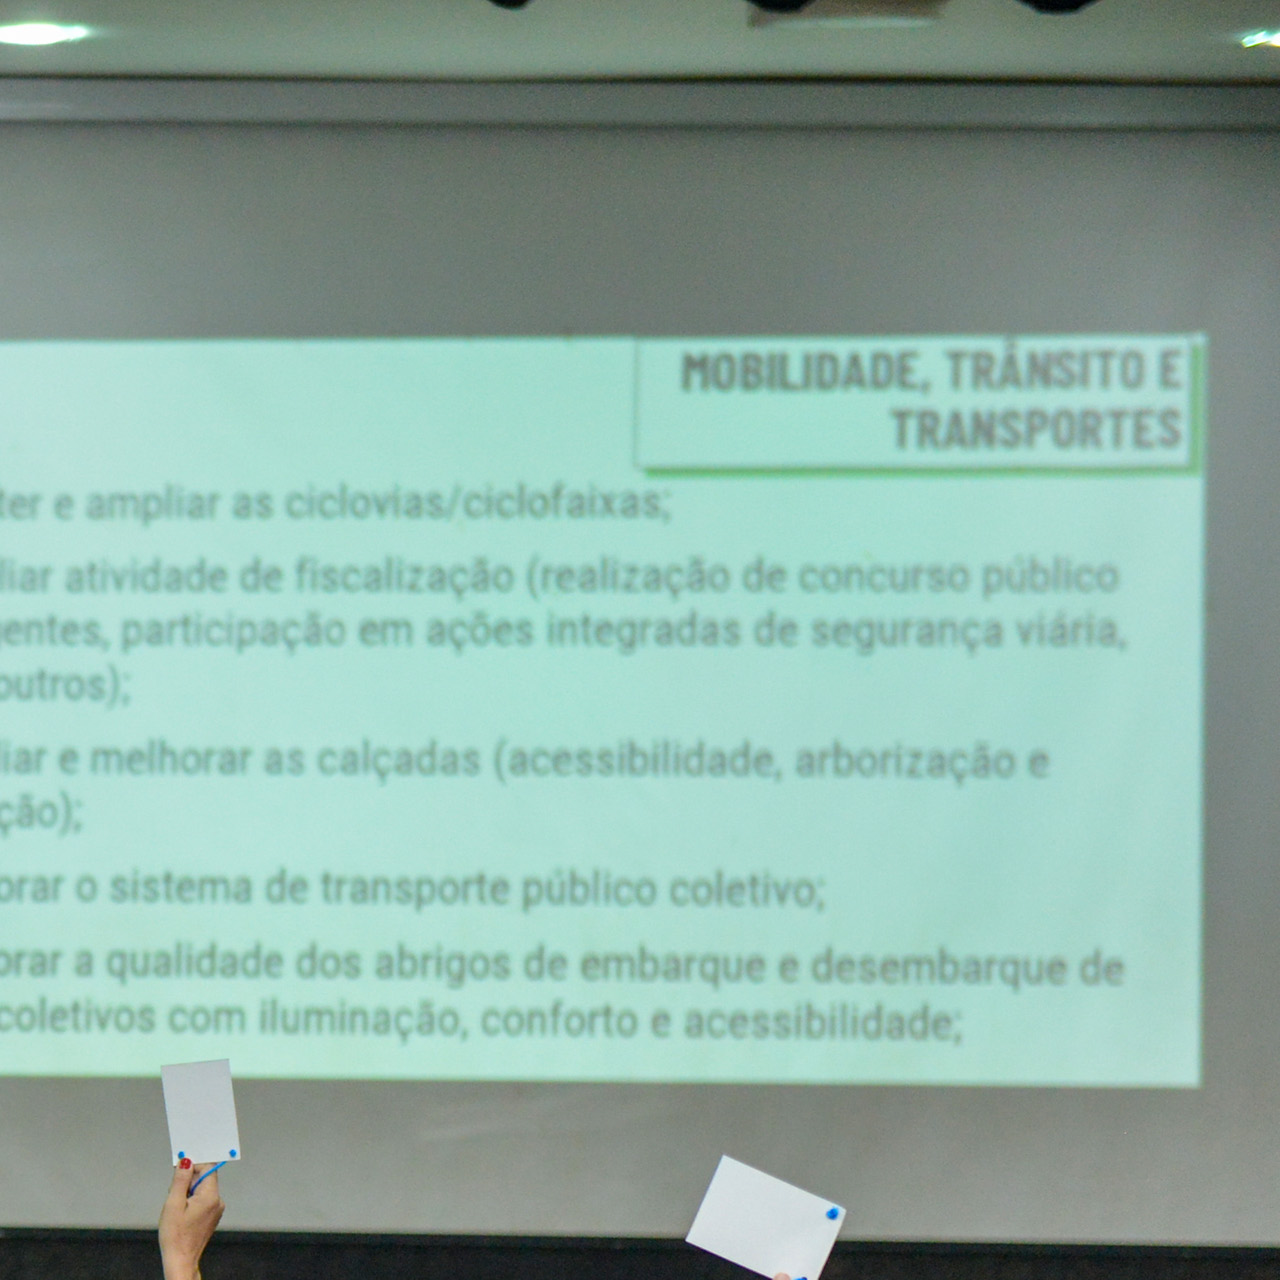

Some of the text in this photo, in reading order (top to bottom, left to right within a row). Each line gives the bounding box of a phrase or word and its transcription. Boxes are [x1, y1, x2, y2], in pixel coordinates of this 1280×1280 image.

[680, 338, 1181, 396] MOBILIDADE, TRÂNSITO E
[892, 408, 1180, 450] TRANSPORTES
[53, 493, 73, 521] e
[84, 484, 221, 526] ampliar
[232, 491, 274, 521] as
[286, 479, 673, 523] ciclovias/ciclofaixas;
[64, 557, 228, 593] atividade
[239, 556, 284, 592] de
[295, 555, 514, 597] fiscalização
[525, 555, 731, 596] (realização
[742, 555, 787, 592] de
[798, 562, 970, 592] concurso
[981, 554, 1121, 597] público
[120, 612, 346, 656] participação
[357, 619, 413, 648] em
[425, 613, 534, 655] ações
[546, 613, 742, 656] integradas
[754, 611, 799, 648] de
[811, 620, 1004, 657] segurança
[1016, 616, 1128, 652] viária,
[58, 746, 80, 775] e
[90, 738, 252, 776] melhorar
[263, 747, 305, 776] as
[317, 738, 481, 785] calçadas
[493, 737, 782, 783] (acessibilidade,
[794, 739, 1016, 787] arborização
[1028, 749, 1050, 779] e
[75, 873, 98, 904] o
[110, 869, 253, 905] sistema
[264, 867, 308, 905] de
[321, 870, 511, 912] transporte
[521, 868, 657, 913] público
[668, 869, 825, 912] coletivo;
[74, 949, 93, 977] a
[106, 942, 284, 983] qualidade
[296, 941, 362, 979] dos
[375, 943, 511, 987] abrigos
[522, 943, 568, 980] de
[580, 944, 766, 987] embarque
[779, 954, 800, 982] e
[811, 945, 1069, 993] desembarque
[1080, 948, 1126, 987] de
[169, 1006, 245, 1034] com
[259, 1000, 469, 1042] iluminação,
[480, 1001, 639, 1039] conforto
[650, 1010, 672, 1038] e
[684, 1004, 962, 1045] acessibilidade;
